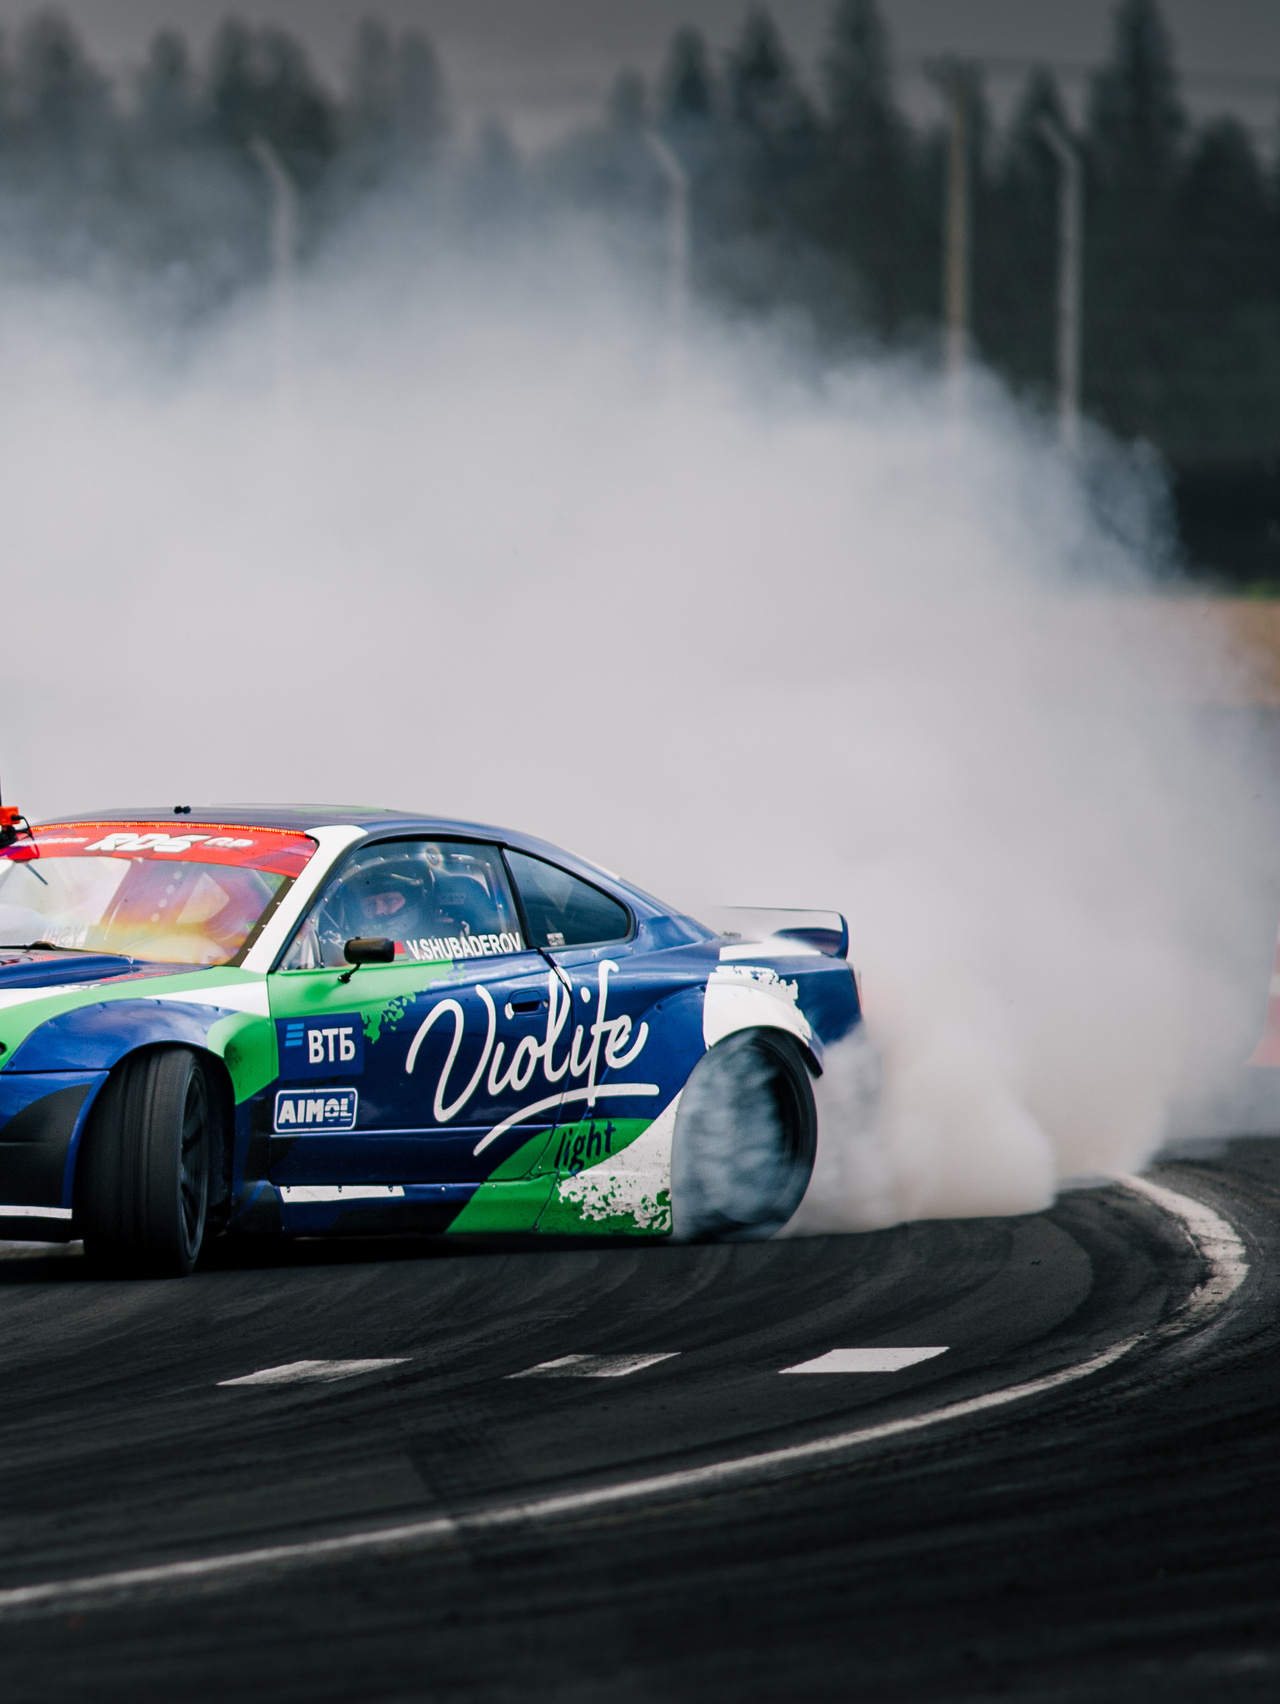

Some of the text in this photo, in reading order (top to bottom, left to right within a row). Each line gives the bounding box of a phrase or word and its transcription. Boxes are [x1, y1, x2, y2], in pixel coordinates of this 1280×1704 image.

[84, 833, 212, 852] RDS
[406, 932, 520, 960] V.SHUBADEROV
[307, 1027, 356, 1064] ВТБ
[405, 959, 649, 1122] Violife
[278, 1098, 352, 1123] AIMOL
[554, 1121, 616, 1175] light
